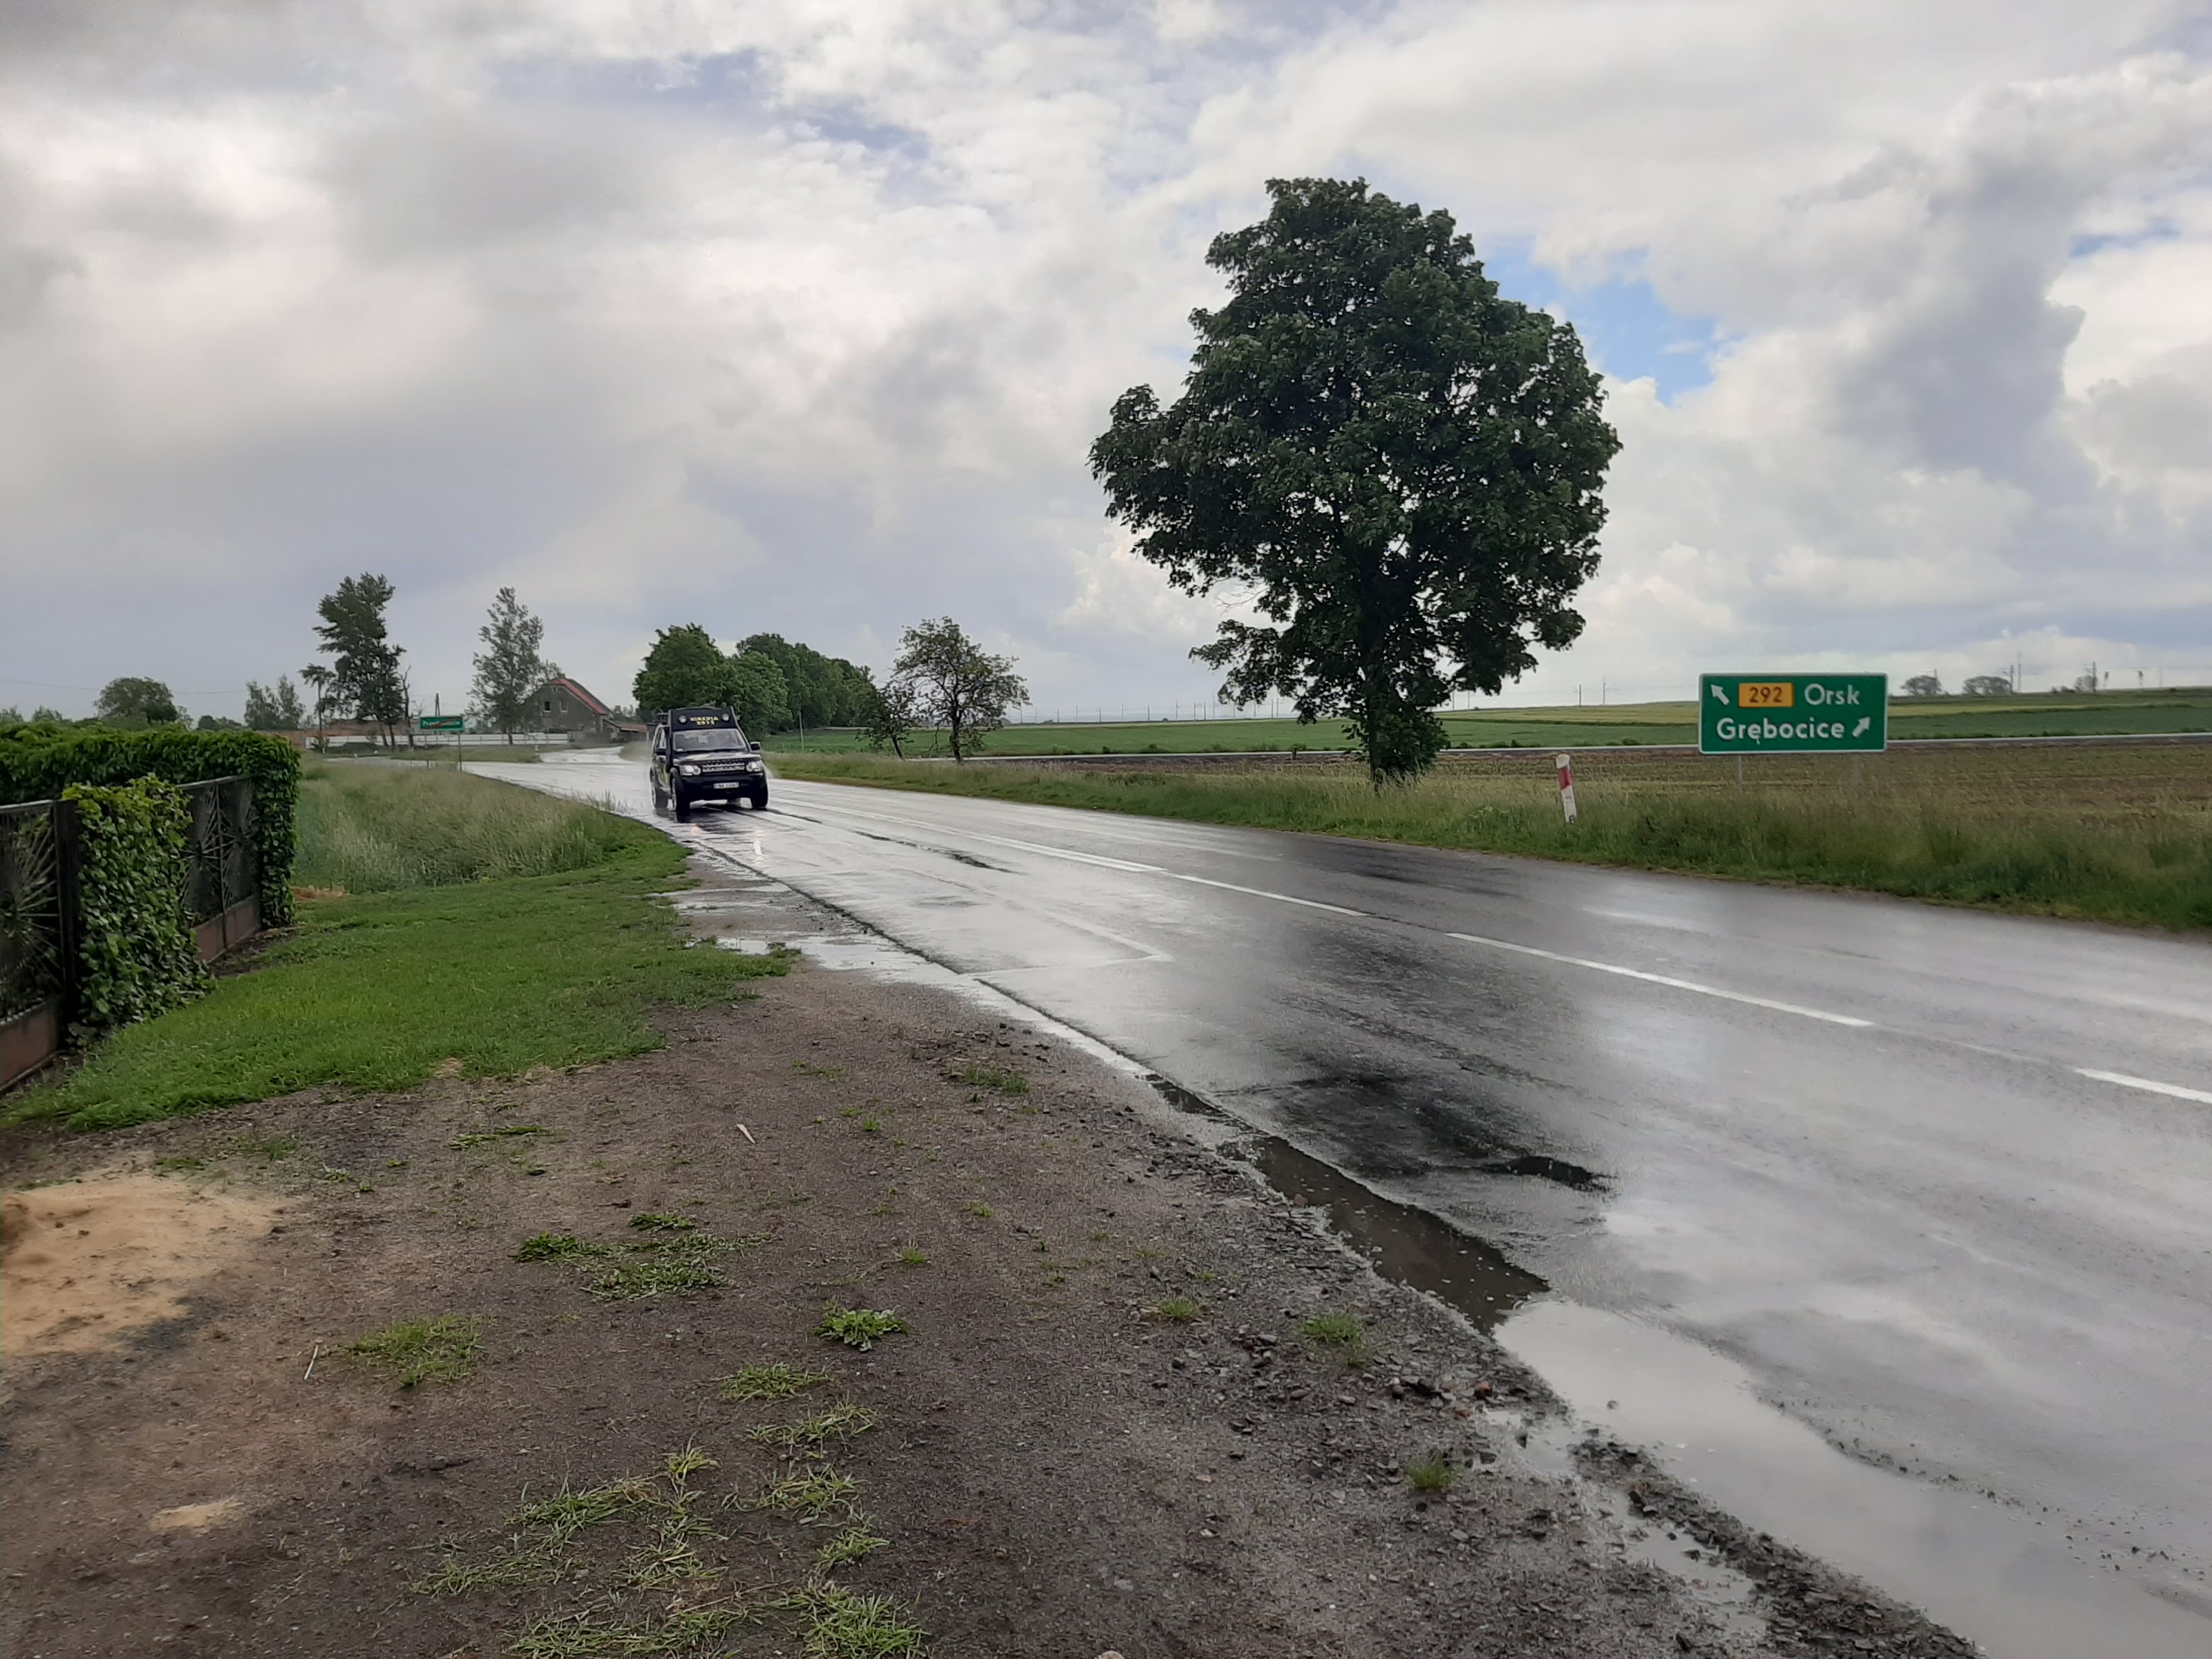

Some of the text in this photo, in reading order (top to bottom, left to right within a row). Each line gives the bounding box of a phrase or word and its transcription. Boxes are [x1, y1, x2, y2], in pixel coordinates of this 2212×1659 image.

[1748, 684, 1860, 706] 292 Orsk
[1717, 717, 1845, 744] Grębocice
